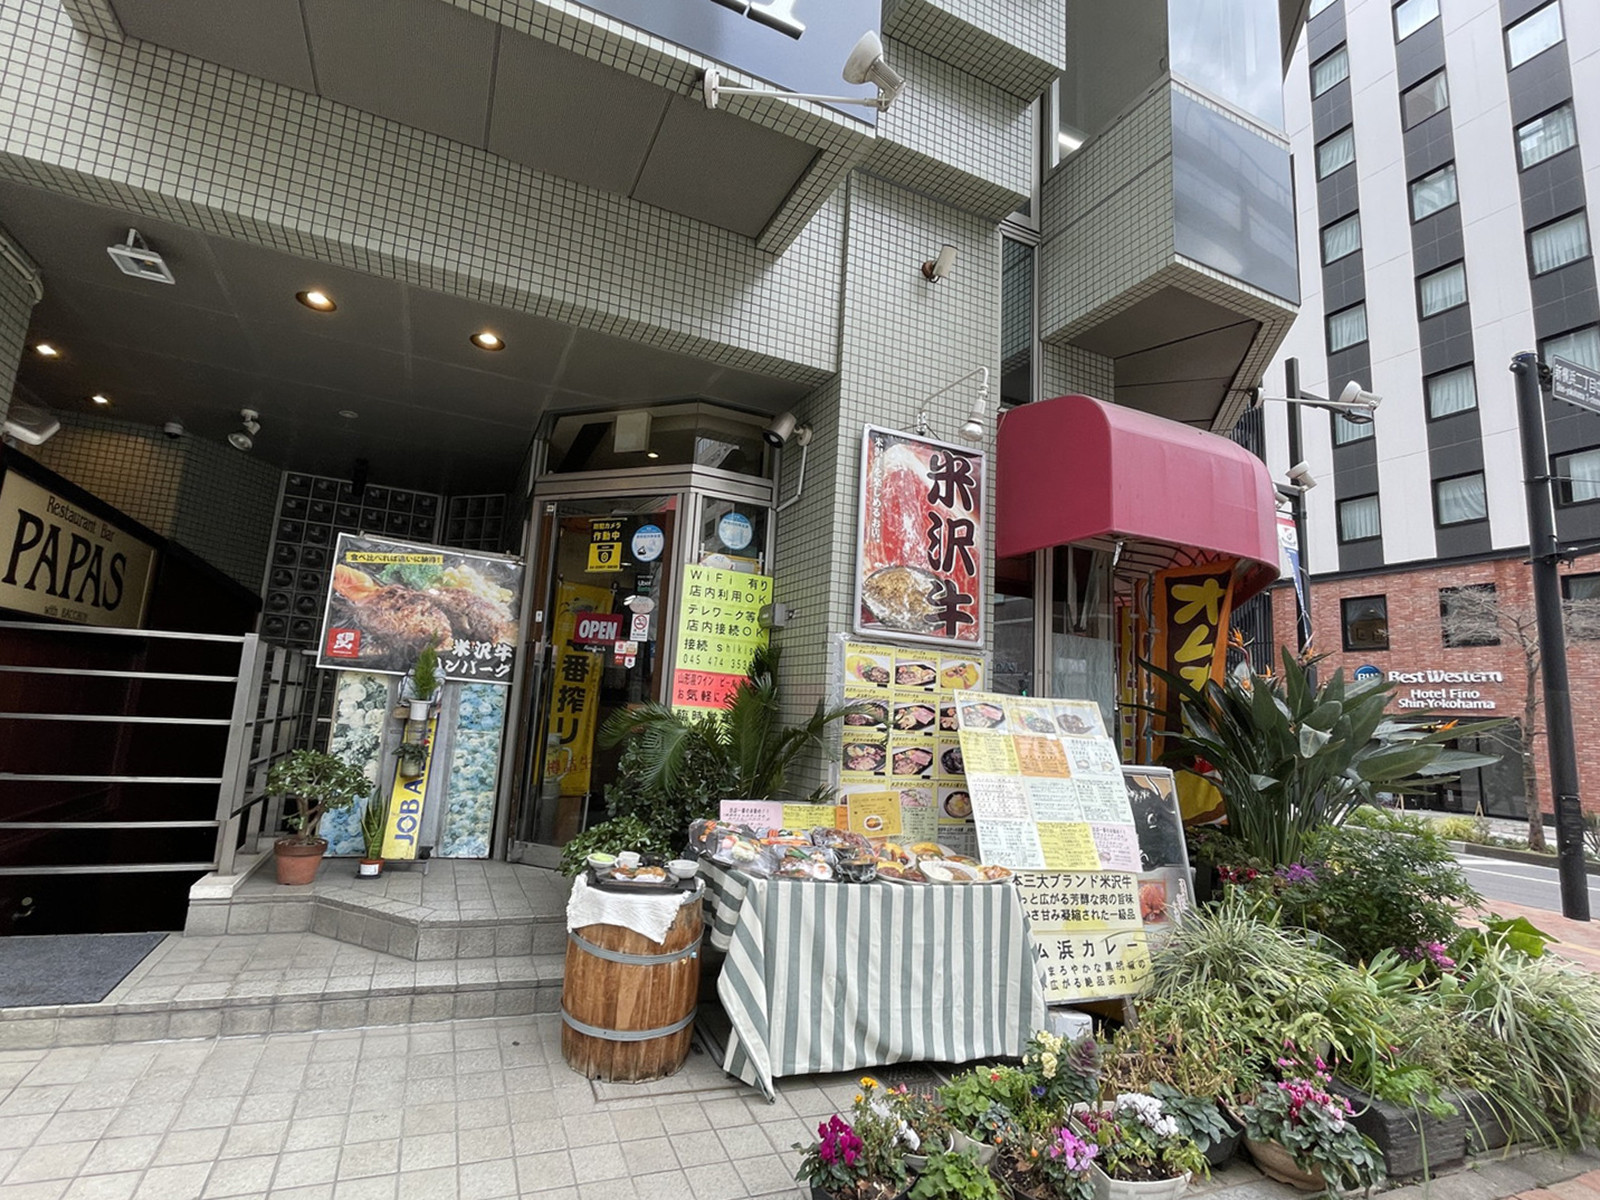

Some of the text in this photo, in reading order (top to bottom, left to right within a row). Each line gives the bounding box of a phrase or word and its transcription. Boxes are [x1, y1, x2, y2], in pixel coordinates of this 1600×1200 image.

[46, 496, 115, 542] Restaurant Bar
[593, 531, 620, 541] 作動中
[924, 451, 975, 638] 米沢牛
[2, 508, 127, 611] PAPAS
[690, 569, 768, 592] WiFi 有り
[689, 585, 767, 605] 店内利用OK
[688, 604, 756, 623] テレワーク等
[579, 619, 618, 640] OPEN
[686, 619, 764, 638] 店内接続OK
[452, 638, 513, 661] 米沢牛
[684, 638, 708, 652] 接続
[683, 654, 701, 665] 045
[708, 657, 724, 666] 474
[1388, 670, 1425, 683] Best
[1426, 670, 1503, 684] Western
[1410, 689, 1480, 699] Hotel Fino
[1398, 699, 1496, 710] Shin-Yokohama
[394, 799, 420, 846] JOB
